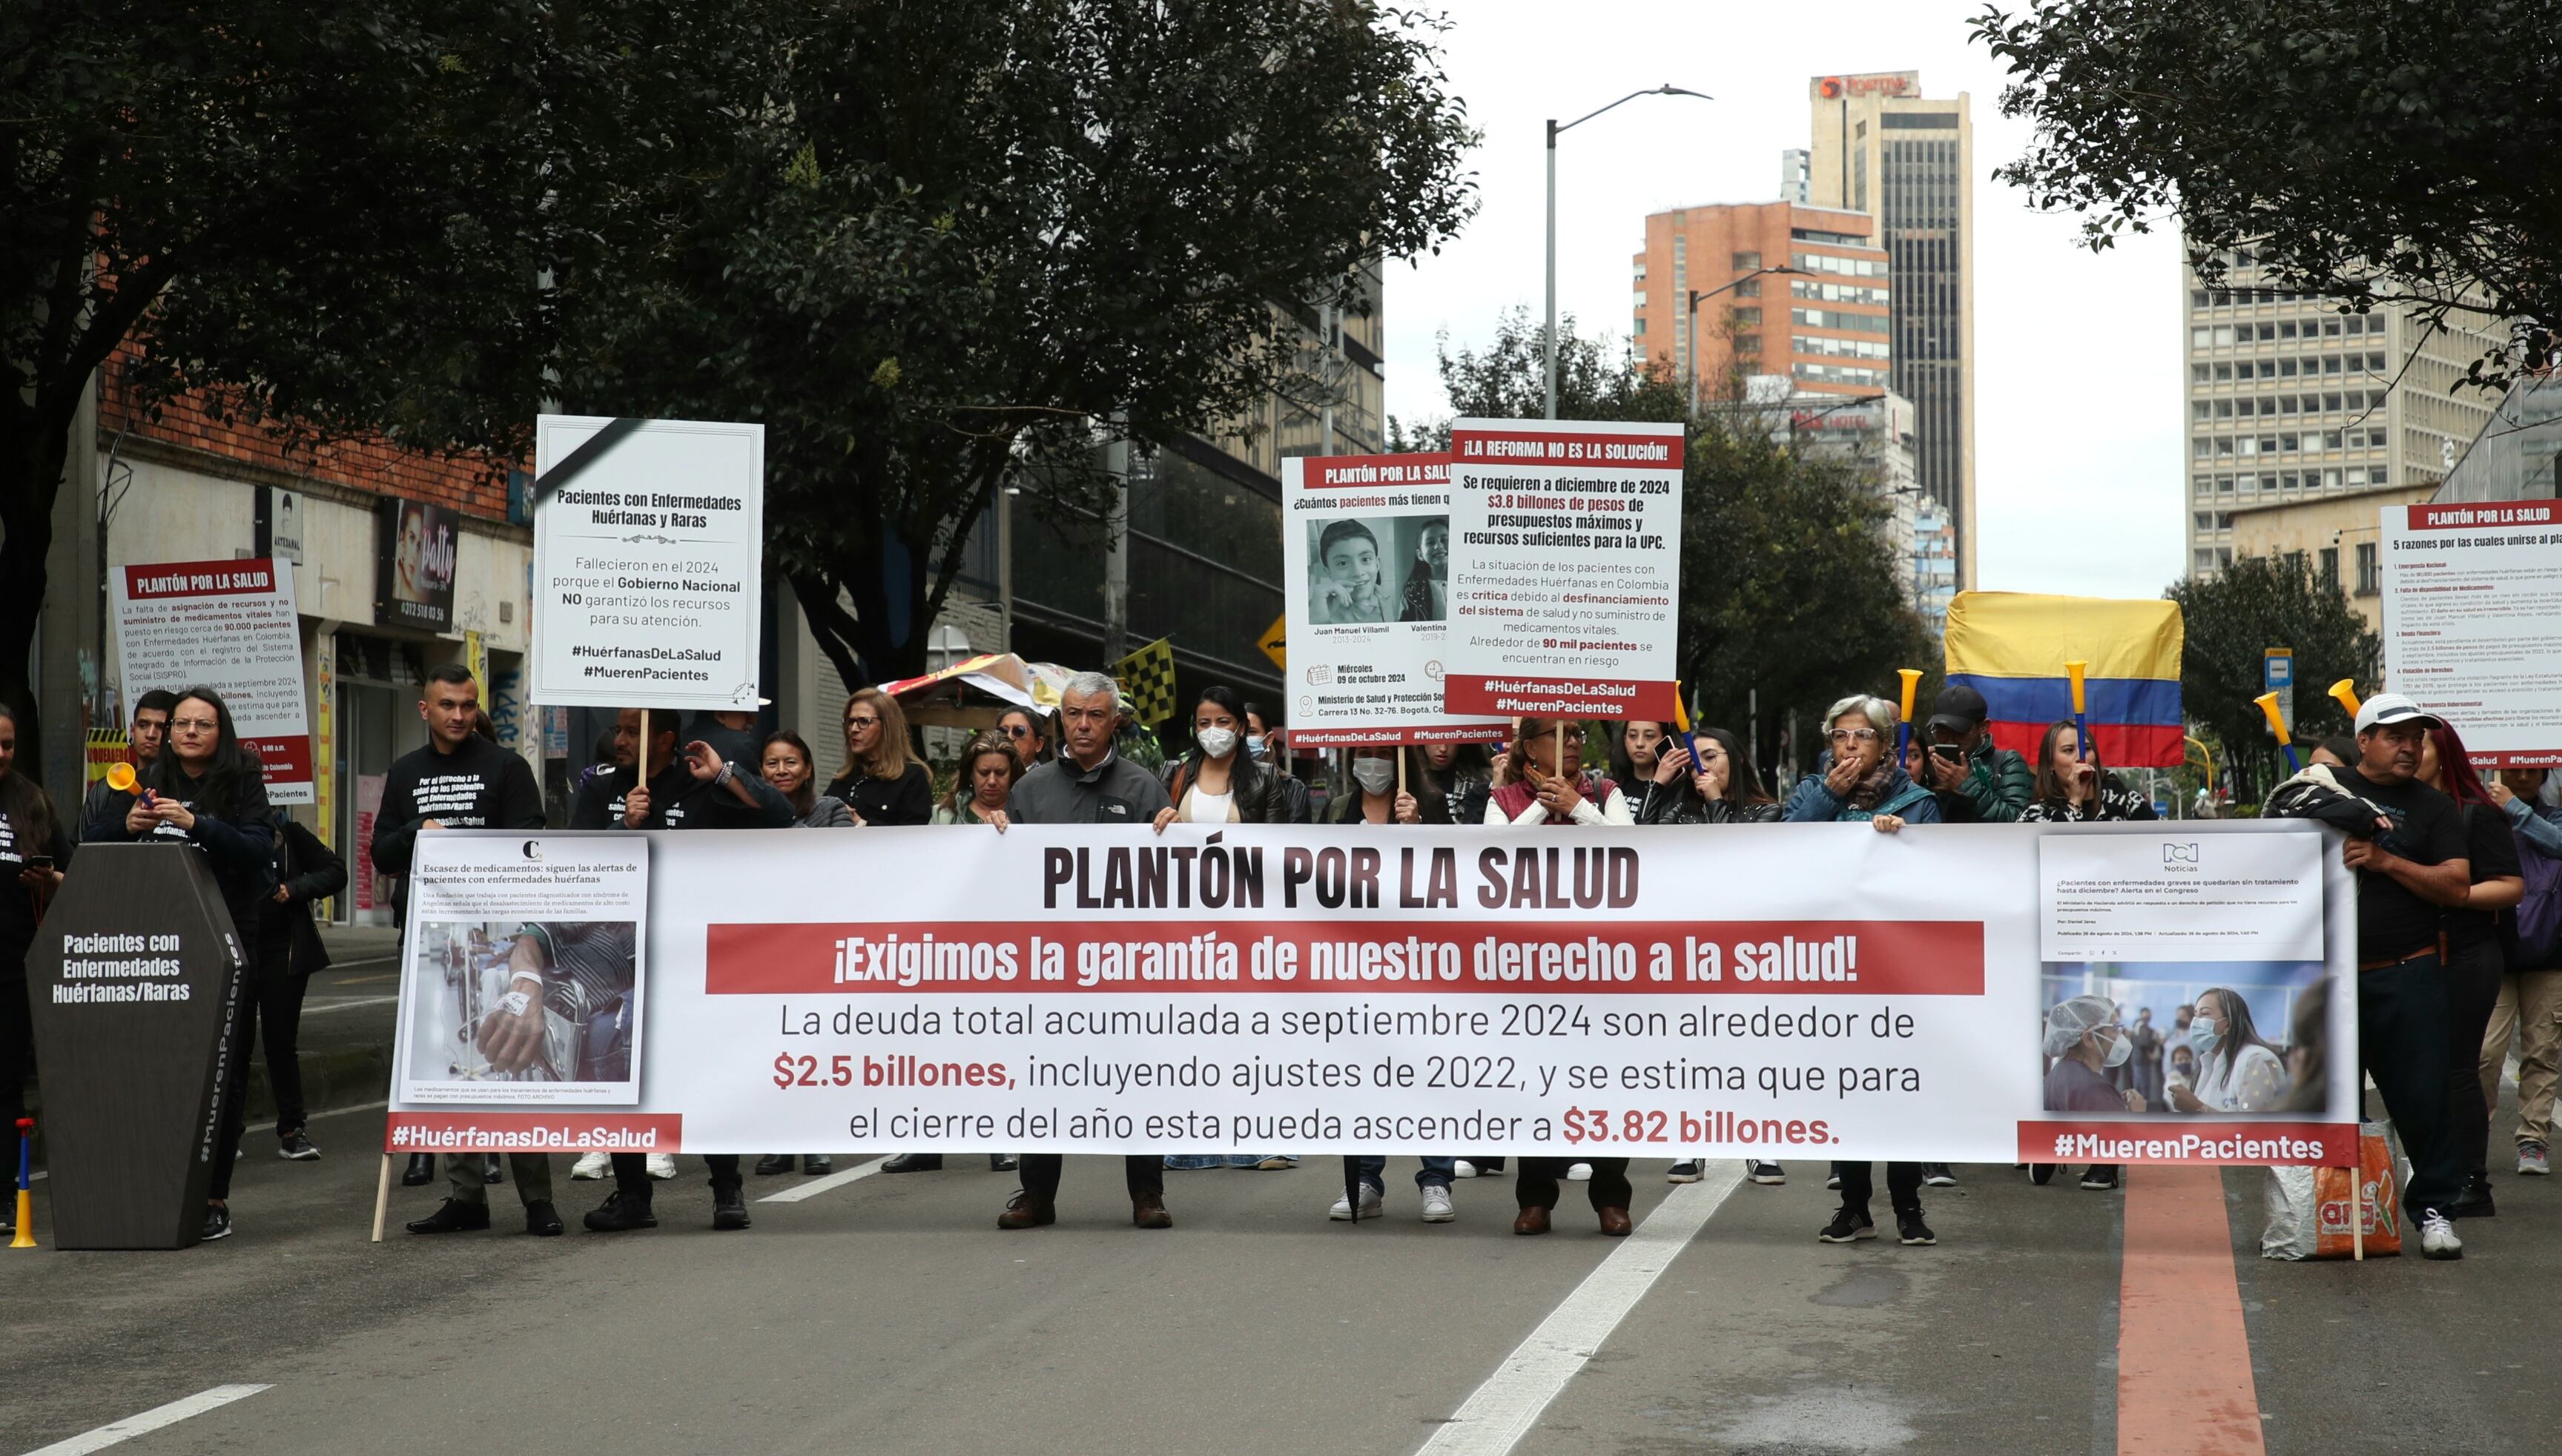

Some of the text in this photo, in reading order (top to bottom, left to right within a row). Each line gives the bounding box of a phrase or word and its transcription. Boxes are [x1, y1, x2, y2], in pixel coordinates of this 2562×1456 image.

[1829, 415, 1868, 428] HOTEL
[1465, 440, 1667, 460] ¡LA REFORMA NO ES LA SOLUCIÓN!
[1326, 463, 1450, 483] PLANTÓN POR LA SALU
[1464, 475, 1669, 494] Se requieren a diciembre de 2024
[557, 489, 741, 509] Pacientes con Enfermedades
[1294, 497, 1336, 509] ¿Cuántos
[1340, 495, 1385, 509] pacientes
[1389, 494, 1408, 506] más
[1411, 494, 1440, 504] tienen
[592, 509, 706, 528] Huérfanas y Raras
[2428, 508, 2549, 525] PLANTÓN POR LA SALUD
[2394, 535, 2547, 549] 5 razones por las cuales unirse al
[576, 557, 718, 573] Fallecieron en el 2024
[137, 572, 268, 593] PLANTÓN POR LA SALUD
[553, 577, 739, 592] porque el Gobierno Nacional
[1472, 590, 1508, 600] crítica
[1511, 592, 1548, 601] debido
[1551, 592, 1559, 602] al
[1563, 593, 1668, 605] desfinanciamiento
[123, 616, 165, 624] suministro
[185, 612, 242, 621] medicamentos
[1503, 622, 1619, 635] medicamentos vitales.
[144, 637, 199, 646] Enfermedades
[572, 646, 720, 661] #HuérfanasDeLaSalud
[584, 666, 707, 680] #MuerenPacientes
[1338, 664, 1372, 672] Miércoles
[1337, 675, 1346, 684] 09
[1358, 675, 1385, 683] octubre
[1388, 674, 1404, 682] 2024
[1485, 681, 1635, 696] #HuérfanasDeLaSalud
[1496, 698, 1622, 713] #MuerenPacientes
[1295, 729, 1502, 742] #HuérfanasDeLaSalud #MuerenPacientes
[546, 864, 575, 873] siguen
[578, 864, 590, 872] las
[626, 863, 636, 871] de
[1044, 833, 1639, 908] PLANTÓN POR LA SALUD
[65, 933, 179, 953] Pacientes con
[834, 931, 1857, 986] ¡Exigimos la garantía de nuestro derecho a la salud!
[63, 957, 179, 978] Enfermedades
[53, 982, 189, 1003] Huérfanas/Raras
[782, 1004, 1914, 1043] La deuda total acumulada a septiembre 2024 son alrededor de
[201, 933, 242, 1163] #MuerenPacientes
[774, 1052, 1919, 1099] $2.5 billones, incluyendo ajustes de 2022, y se estima que para
[393, 1126, 656, 1148] #HuérfanasDeLaSalud
[2055, 1134, 2323, 1159] #MuerenPacientes
